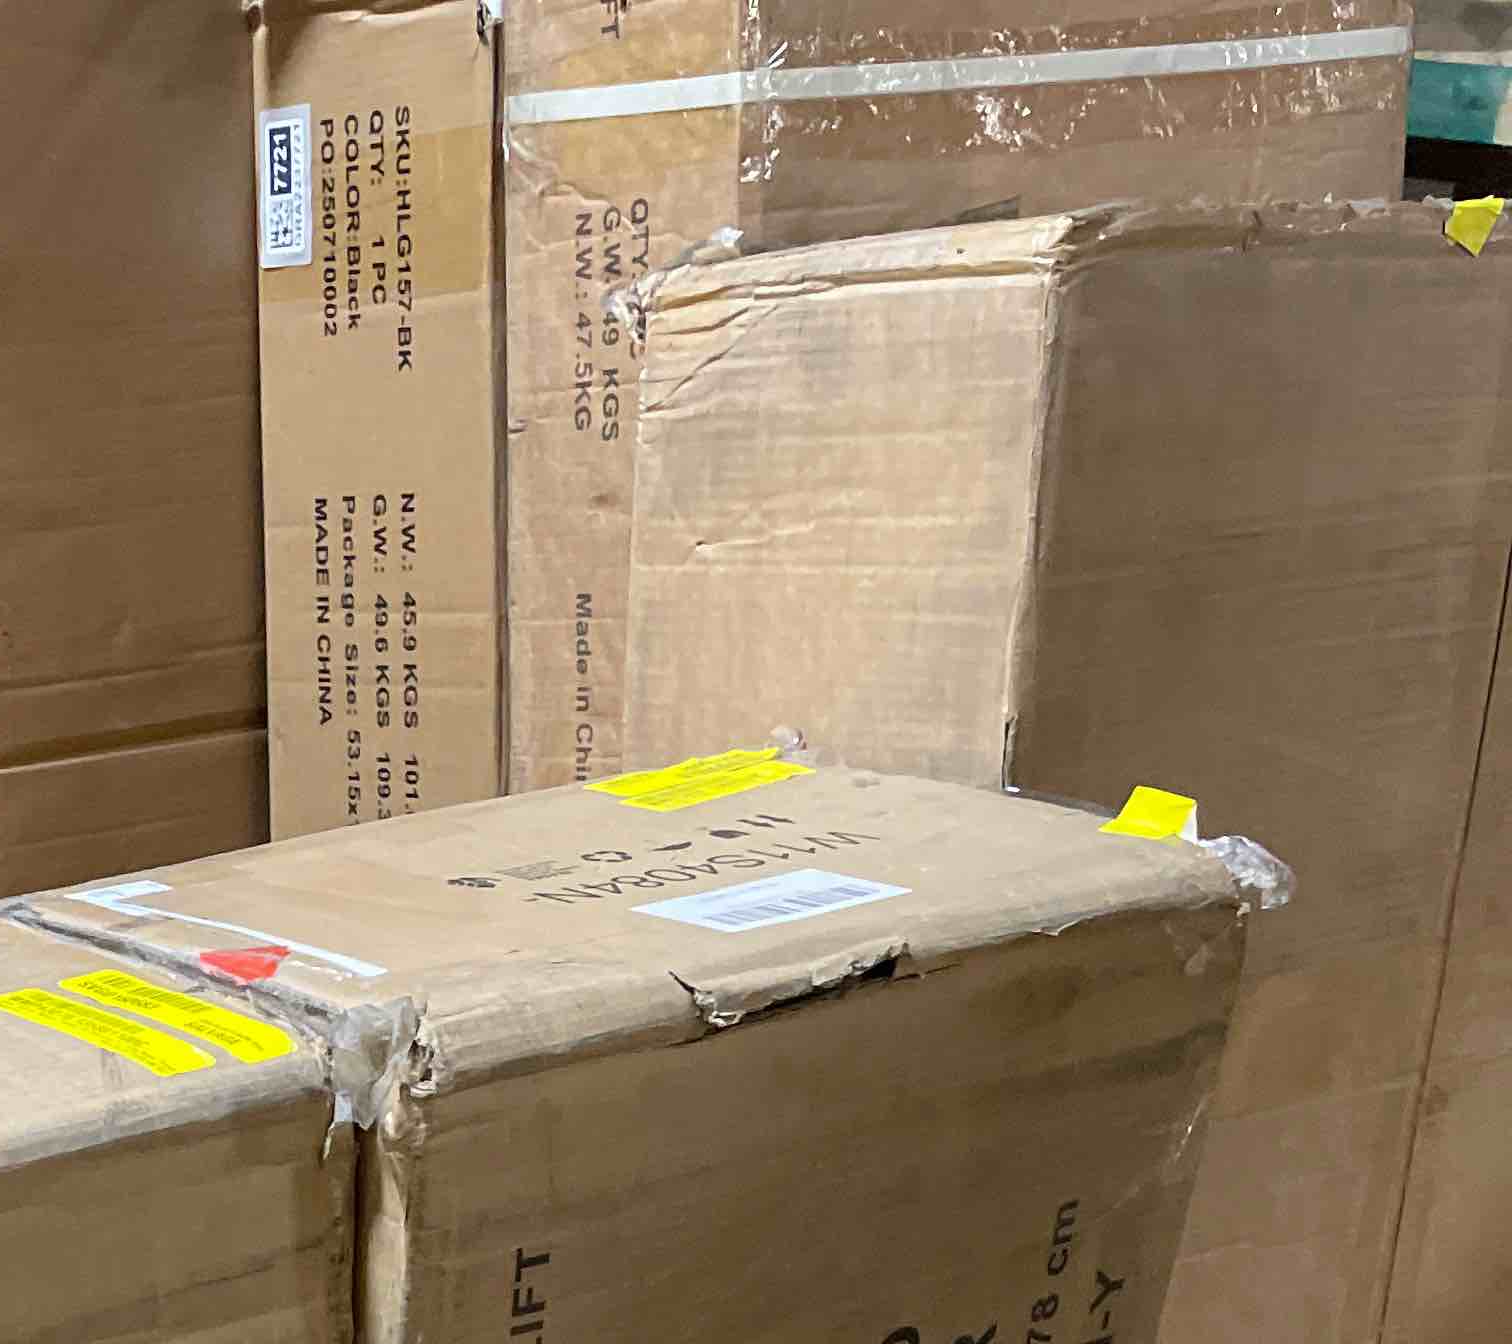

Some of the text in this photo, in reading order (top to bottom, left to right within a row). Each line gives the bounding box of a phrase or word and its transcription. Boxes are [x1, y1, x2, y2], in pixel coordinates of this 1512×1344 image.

[272, 132, 290, 192] 7721
[319, 118, 338, 337] PO:250710002
[344, 114, 361, 329] COLOR:Black
[369, 109, 387, 305] QTY: 1 PC
[395, 105, 412, 371] SKU:HLG157-BK
[574, 212, 594, 431] N.W.: 47.5KG
[601, 367, 619, 442] KGS
[372, 493, 388, 574] G.W.:
[400, 492, 417, 572] N.W.:
[313, 497, 333, 727] MADE IN CHINA
[374, 593, 390, 653] 49.6
[402, 591, 418, 652] 45.9
[576, 593, 593, 675] Made
[340, 494, 361, 824] Package Size: 53.15x
[375, 664, 391, 730] KGS
[403, 663, 419, 730] KGS
[1046, 1198, 1080, 1278] cm
